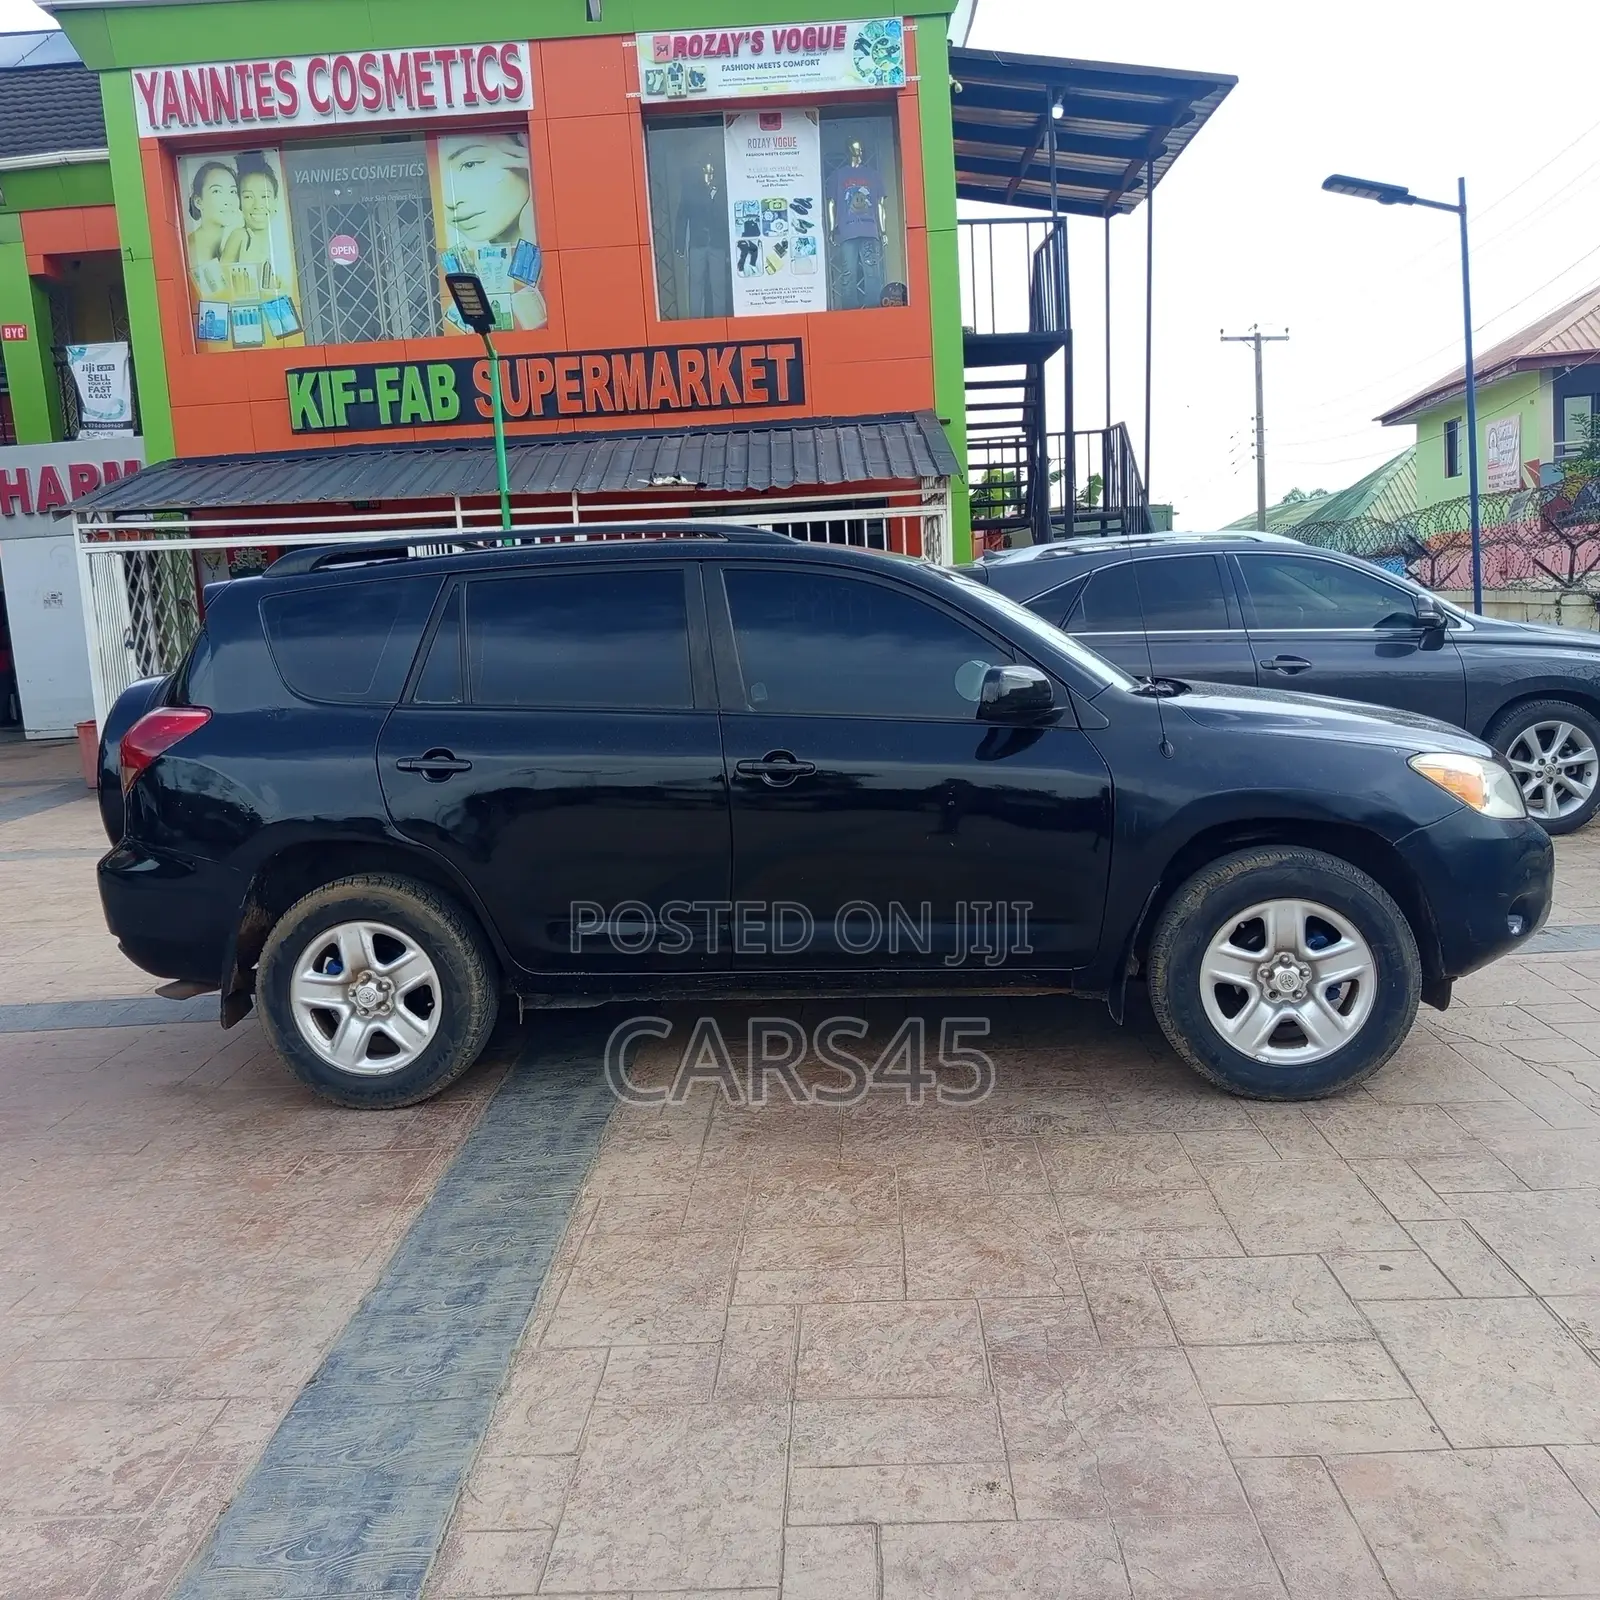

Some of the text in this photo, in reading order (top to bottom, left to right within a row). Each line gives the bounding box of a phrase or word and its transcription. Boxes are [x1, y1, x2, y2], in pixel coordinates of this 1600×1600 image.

[673, 30, 765, 61] ROZAY'S
[772, 25, 847, 54] VOGUE
[721, 58, 820, 72] FASHION MEETS COMFORT
[134, 43, 525, 129] YANNIES COSMETICS
[747, 136, 797, 149] ROZAY VOGUE
[294, 163, 425, 184] YANNIES COSMETICS
[330, 245, 356, 256] OPEN
[5, 327, 24, 339] BYC
[287, 343, 797, 432] KIF-FAB SUPERMARKET
